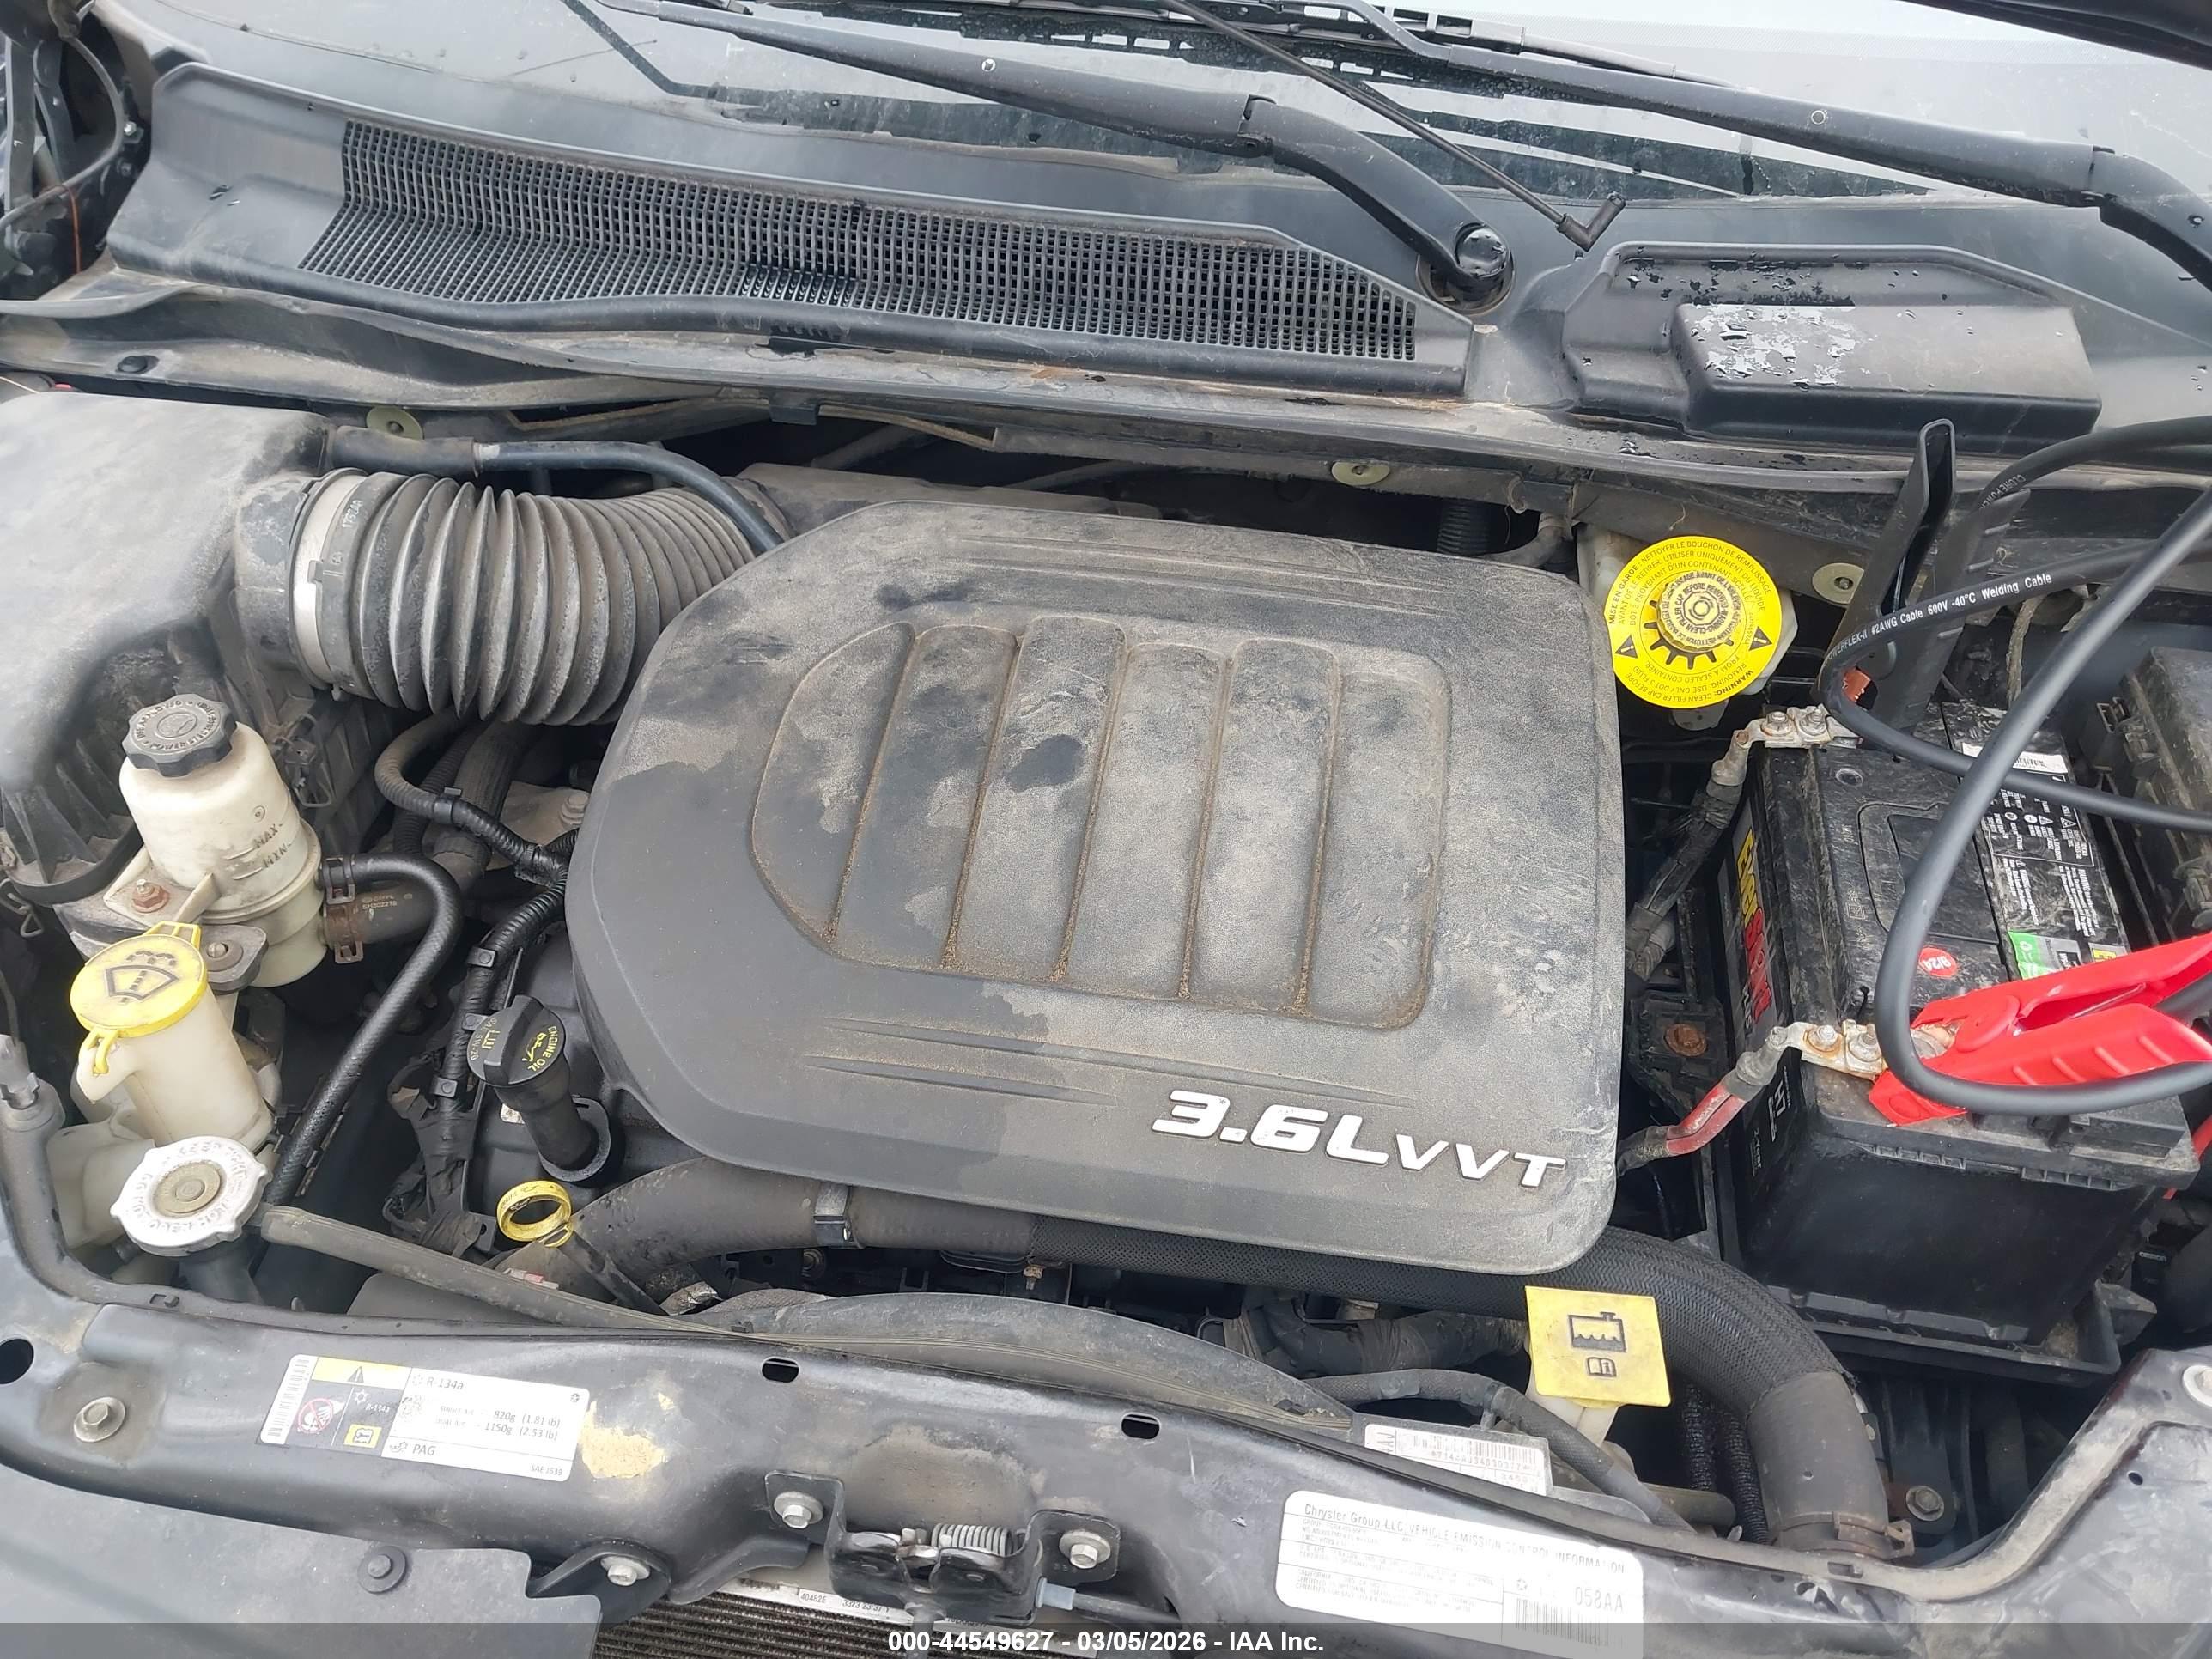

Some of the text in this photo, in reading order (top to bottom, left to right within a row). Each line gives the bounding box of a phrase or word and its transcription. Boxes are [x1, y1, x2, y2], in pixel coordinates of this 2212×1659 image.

[1608, 604, 1618, 624] MISE
[1613, 591, 1622, 602] EN
[1619, 564, 1639, 589] GARDE
[1641, 543, 1674, 563] NETTOYER
[1686, 540, 1724, 553] BOUCHON
[1725, 548, 1735, 557] DE
[1736, 554, 1771, 595] REMPLISSAGE
[1634, 568, 1667, 602] PROVENANT
[1687, 560, 1732, 578] CONTENANT
[1662, 550, 1694, 562] UTILISER
[1696, 550, 1743, 574] UNIQUEMENT
[1741, 570, 1753, 584] DU
[1751, 583, 1765, 612] LIQUIDE
[1899, 609, 1923, 625] Cable
[1928, 601, 1949, 617] 600V
[1981, 581, 2020, 600] Welding
[2024, 573, 2052, 589] Cable
[1720, 654, 1740, 672] FROM
[1626, 672, 1649, 693] BEFORE
[1632, 665, 1650, 682] FLUID
[1685, 672, 1712, 684] SEALED
[1648, 690, 1662, 699] CAP
[1655, 683, 1670, 691] DOT
[1688, 693, 1712, 702] CLEAN
[1737, 829, 1772, 1023] EverStart
[527, 1024, 558, 1073] ENGINE OIL
[1771, 1079, 1786, 1117] H7
[1395, 1133, 1568, 1190] VVT
[426, 1376, 465, 1390] R-134a
[493, 1411, 516, 1424] 820g
[521, 1413, 545, 1425] (1.81
[547, 1417, 561, 1430] lb)
[484, 1422, 514, 1437] 1150g
[519, 1425, 544, 1439] (2.53
[545, 1429, 559, 1442] lb)
[412, 1443, 436, 1457] PAG
[530, 1464, 544, 1474] SAE
[1304, 1504, 1347, 1522] Chrysler
[1351, 1511, 1381, 1530] Group
[1409, 1524, 1449, 1541] VEHICLE
[1454, 1530, 1502, 1550] EMISSION
